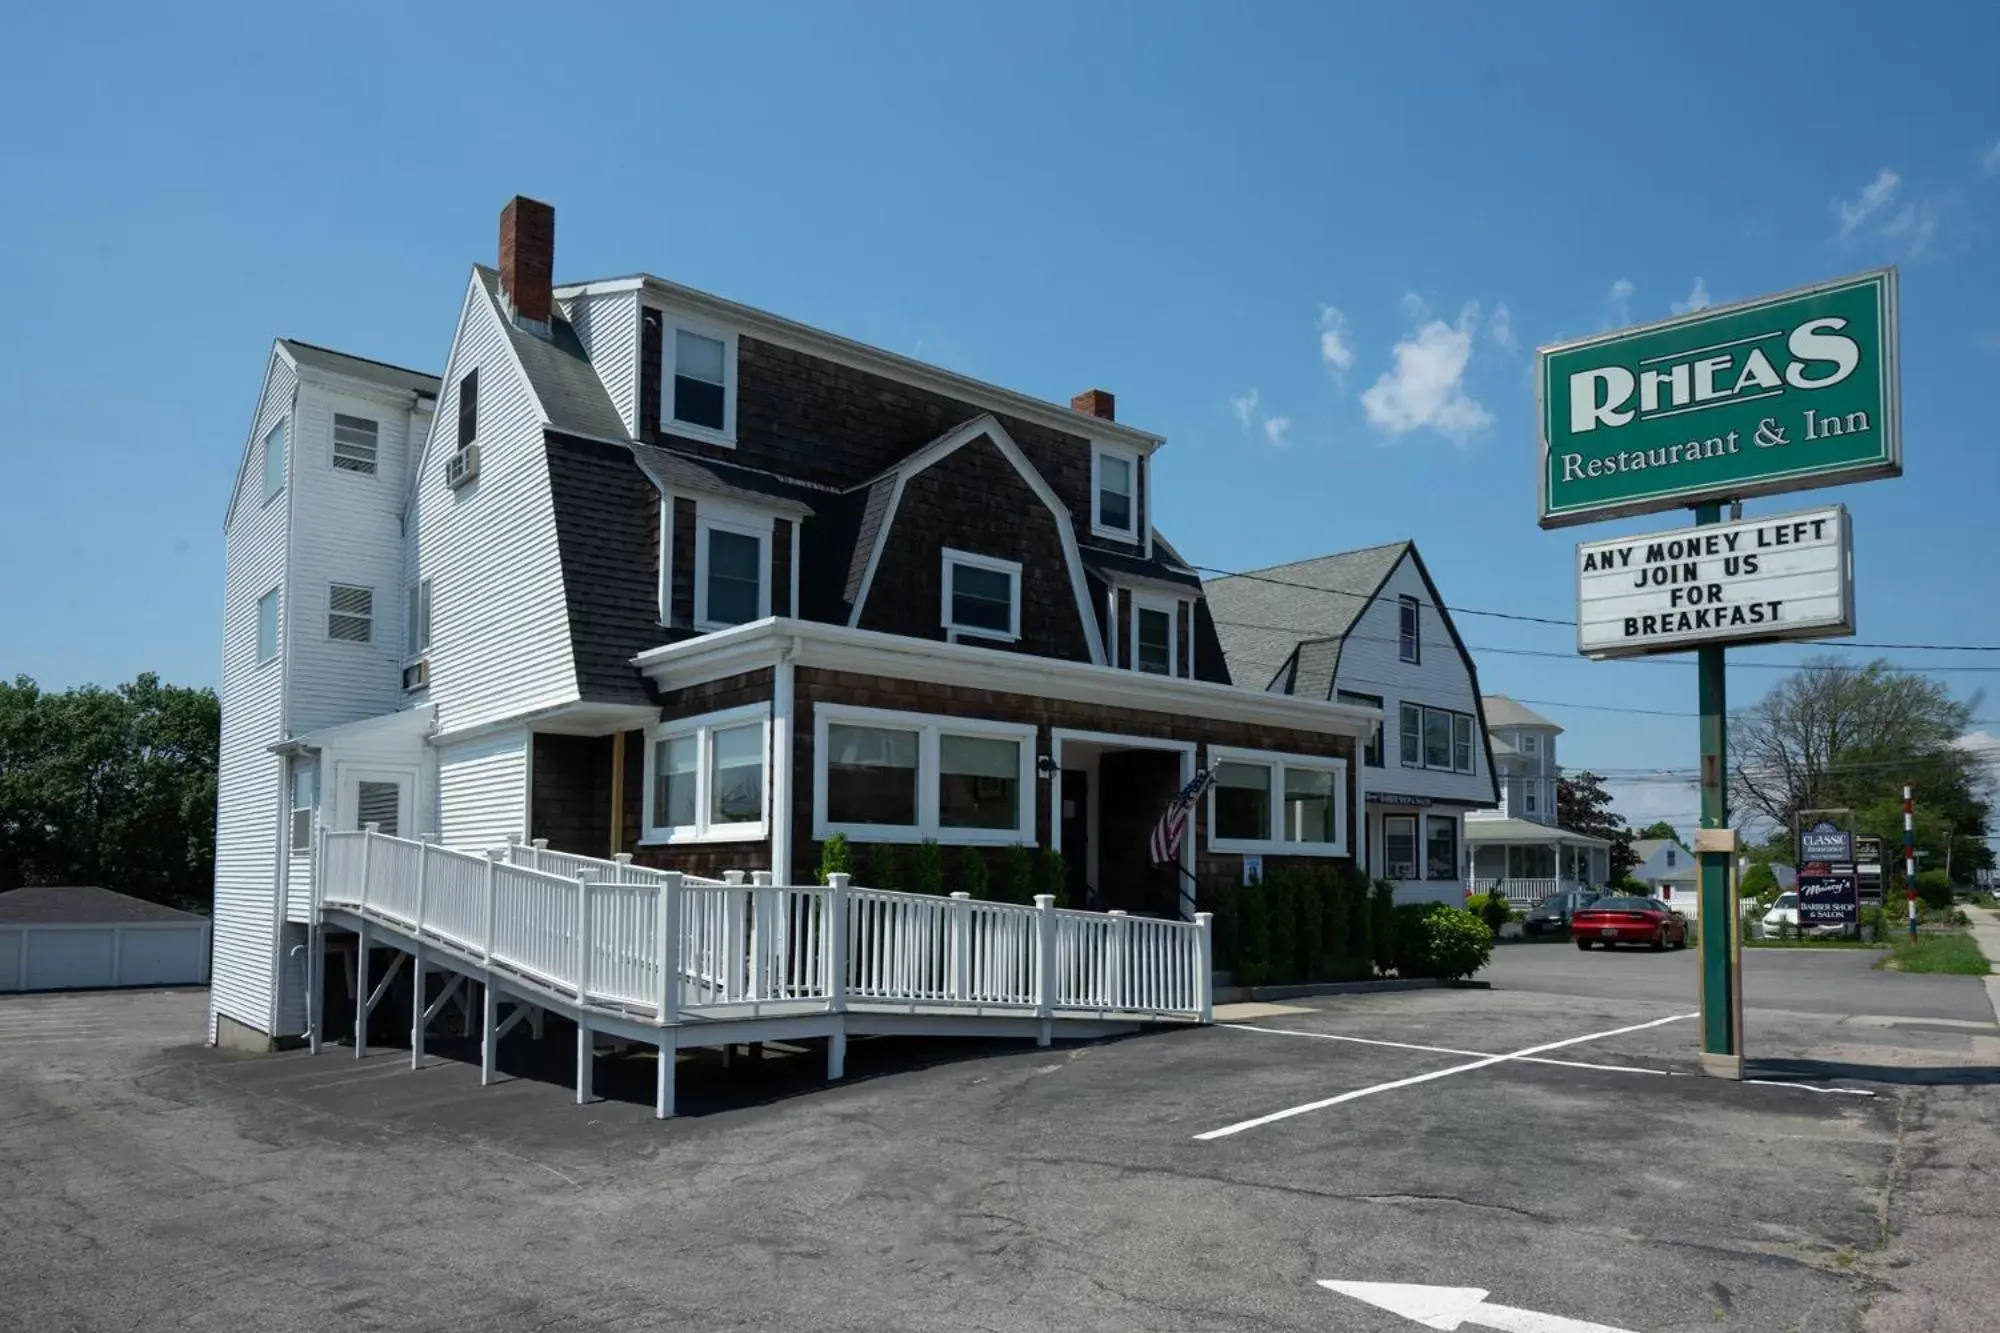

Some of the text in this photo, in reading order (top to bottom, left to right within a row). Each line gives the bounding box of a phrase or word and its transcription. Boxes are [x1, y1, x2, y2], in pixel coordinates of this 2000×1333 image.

[1561, 408, 1871, 482] Restaurant & Inn
[1583, 519, 1827, 572] ANY MONEY LEFT
[1634, 554, 1759, 588] JOIN US
[1670, 583, 1723, 608] FOR
[1624, 600, 1783, 637] BREAKFAST
[1802, 834, 1847, 846] CLASSIC
[1800, 903, 1831, 911] BARBER
[1832, 903, 1856, 911] SHOP
